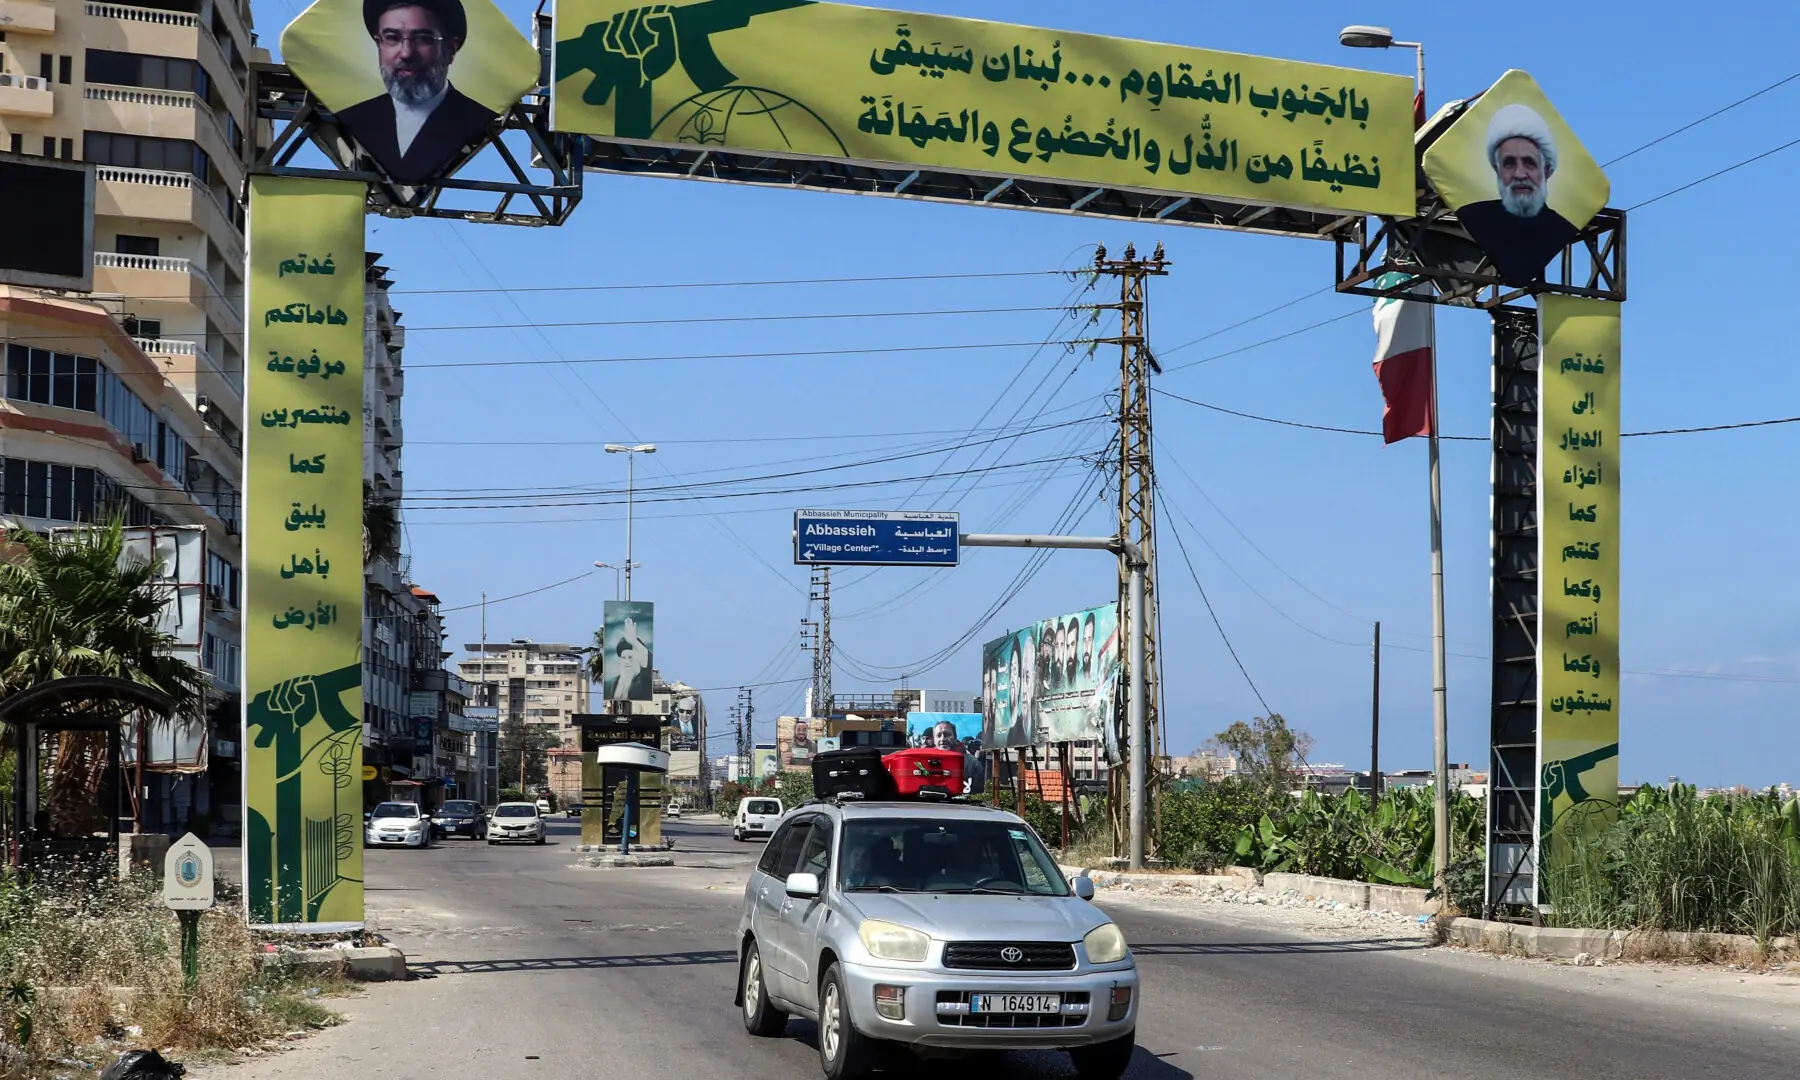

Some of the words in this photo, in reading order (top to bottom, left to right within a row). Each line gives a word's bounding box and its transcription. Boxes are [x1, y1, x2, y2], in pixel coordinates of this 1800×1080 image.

[266, 303, 348, 327] هاماتكم
[268, 349, 345, 380] مرفوعة
[1573, 392, 1594, 414] إلى
[261, 406, 350, 428] منتصرين
[1560, 428, 1601, 450] الديار
[290, 454, 325, 473] كما
[1564, 462, 1601, 489] أعزاء
[285, 503, 325, 531] يليق
[802, 510, 842, 518] Abbassieh
[844, 511, 889, 519] Municipality
[903, 513, 935, 521] العباسية
[936, 513, 955, 521] بلدية
[1570, 503, 1596, 522] كما
[805, 524, 876, 537] Abbassieh
[895, 525, 952, 541] العباسية
[1563, 542, 1599, 562] كنتم
[281, 551, 329, 579] بأهل
[1564, 578, 1600, 603] وكما
[273, 600, 337, 630] الأرض
[1566, 612, 1597, 639] أنتم
[1564, 654, 1600, 678] وكما
[1551, 690, 1611, 715] ستبقون
[630, 730, 655, 742] بلدية
[982, 995, 992, 1012] N
[1001, 995, 1051, 1012] 164914
